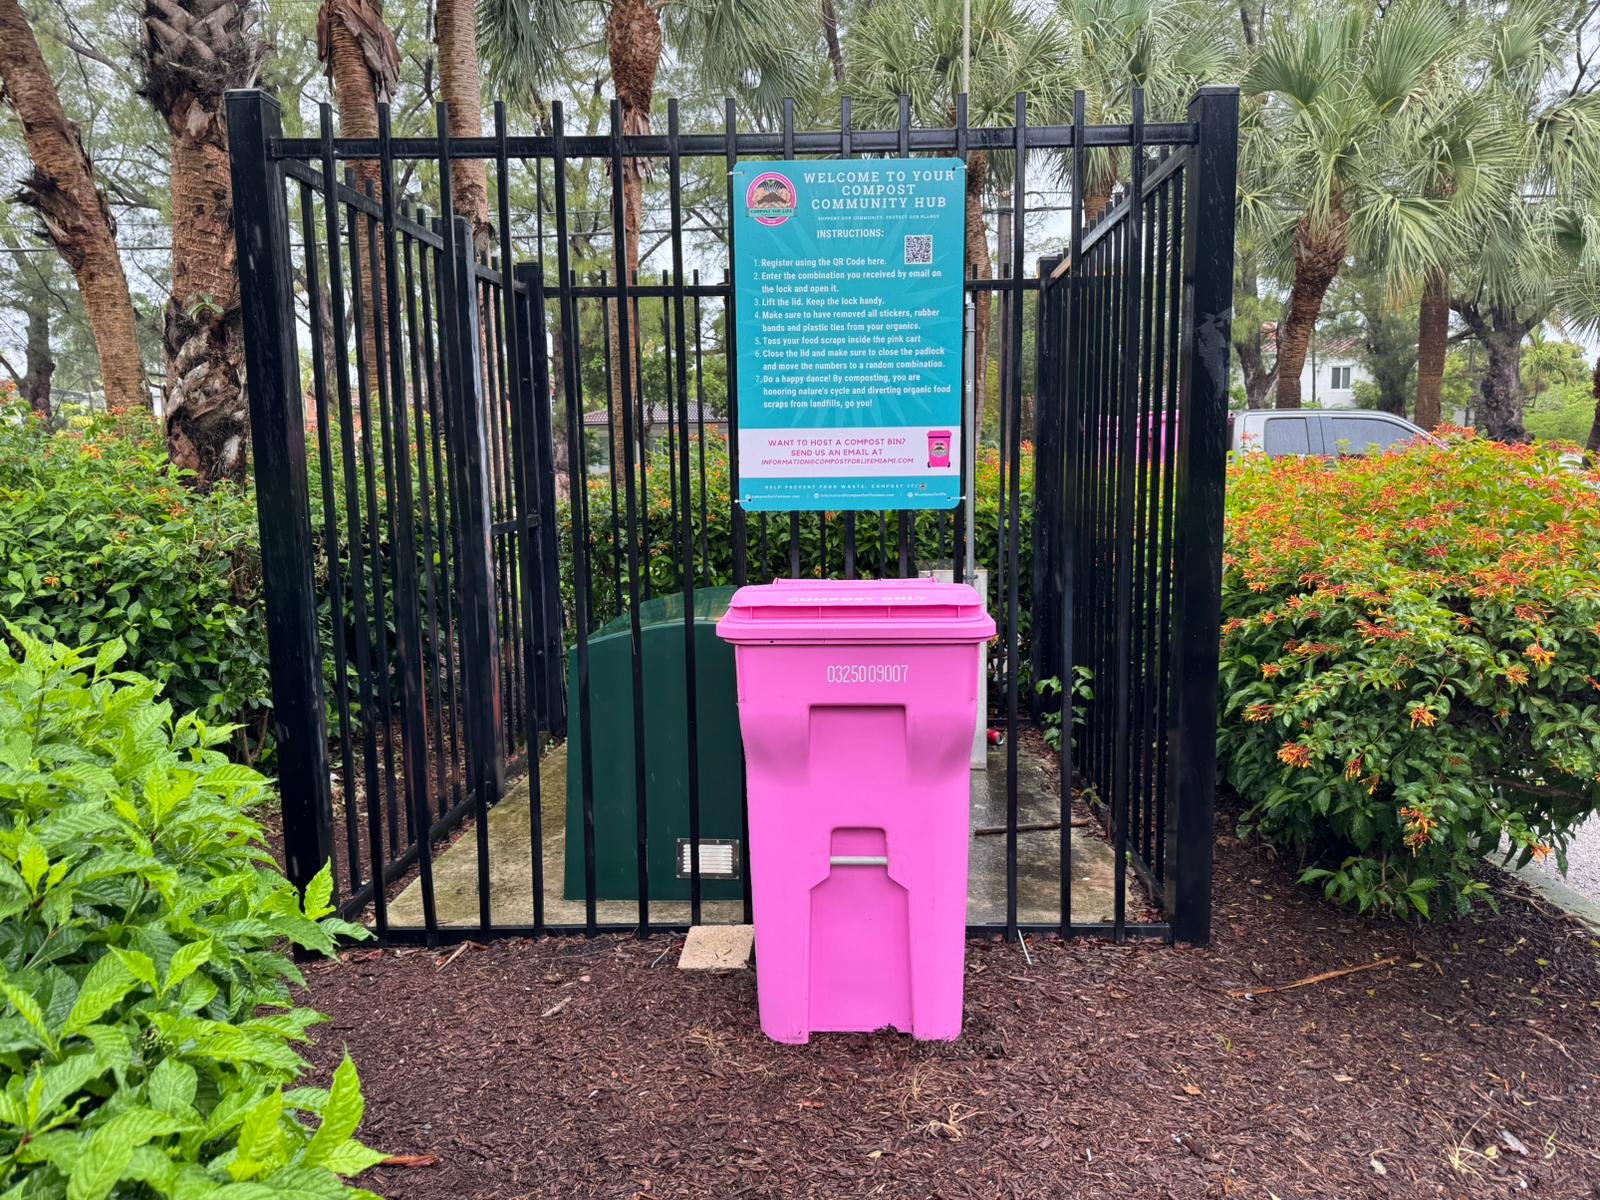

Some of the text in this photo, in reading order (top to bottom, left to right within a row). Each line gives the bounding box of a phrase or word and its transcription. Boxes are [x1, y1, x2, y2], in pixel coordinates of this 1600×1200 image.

[804, 171, 954, 183] WELCOME TO YOUR
[842, 184, 915, 195] COMPOST
[812, 197, 946, 210] COMMUNITY HUB
[817, 229, 884, 238] INSTRUCTIONS:
[754, 259, 760, 267] 1.
[762, 259, 793, 269] Register
[795, 259, 816, 268] using
[833, 258, 844, 266] QR
[846, 258, 866, 266] Code
[868, 257, 887, 265] here.
[754, 272, 760, 280] 2.
[762, 272, 782, 280] Enter
[784, 272, 796, 280] the
[798, 271, 845, 279] combination
[863, 270, 896, 278] received
[898, 270, 907, 280] by
[909, 270, 929, 278] email
[762, 284, 839, 294] the lock and open it.
[754, 297, 885, 307] 3. Lift the lid. Keep the lock handy.
[754, 311, 761, 320] 4.
[762, 311, 782, 319] Make
[813, 310, 831, 318] have
[833, 310, 866, 318] removed
[880, 309, 912, 318] stickers,
[914, 309, 940, 317] rubber
[762, 322, 920, 333] bands and plastic ties from your organics.
[755, 336, 761, 344] 5.
[783, 338, 800, 346] your
[802, 336, 818, 344] food
[820, 337, 845, 346] scraps
[848, 335, 872, 343] inside
[873, 335, 886, 343] the
[888, 335, 905, 343] pink
[907, 335, 920, 343] cart
[755, 350, 761, 358] 6.
[763, 349, 784, 358] Close
[786, 349, 798, 357] the
[800, 349, 809, 357] lid
[812, 349, 825, 357] and
[828, 349, 848, 357] make
[878, 348, 898, 356] close
[900, 348, 913, 356] the
[915, 347, 944, 357] padlock
[763, 362, 777, 370] and
[801, 362, 813, 370] the
[815, 362, 847, 370] numbers
[866, 361, 894, 369] random
[896, 360, 945, 368] combination.
[756, 376, 762, 384] 7.
[764, 375, 773, 383] Do
[782, 375, 804, 385] happy
[806, 374, 831, 383] dance!
[833, 374, 843, 384] By
[844, 374, 890, 384] composting,
[893, 375, 907, 383] you
[764, 385, 951, 397] honoring nature's cycle and diverting organic food
[764, 399, 872, 410] scraps from landfills, go you!
[768, 439, 794, 447] WANT
[844, 438, 884, 446] COMPOST
[888, 438, 906, 446] BIN?
[791, 449, 812, 457] SEND
